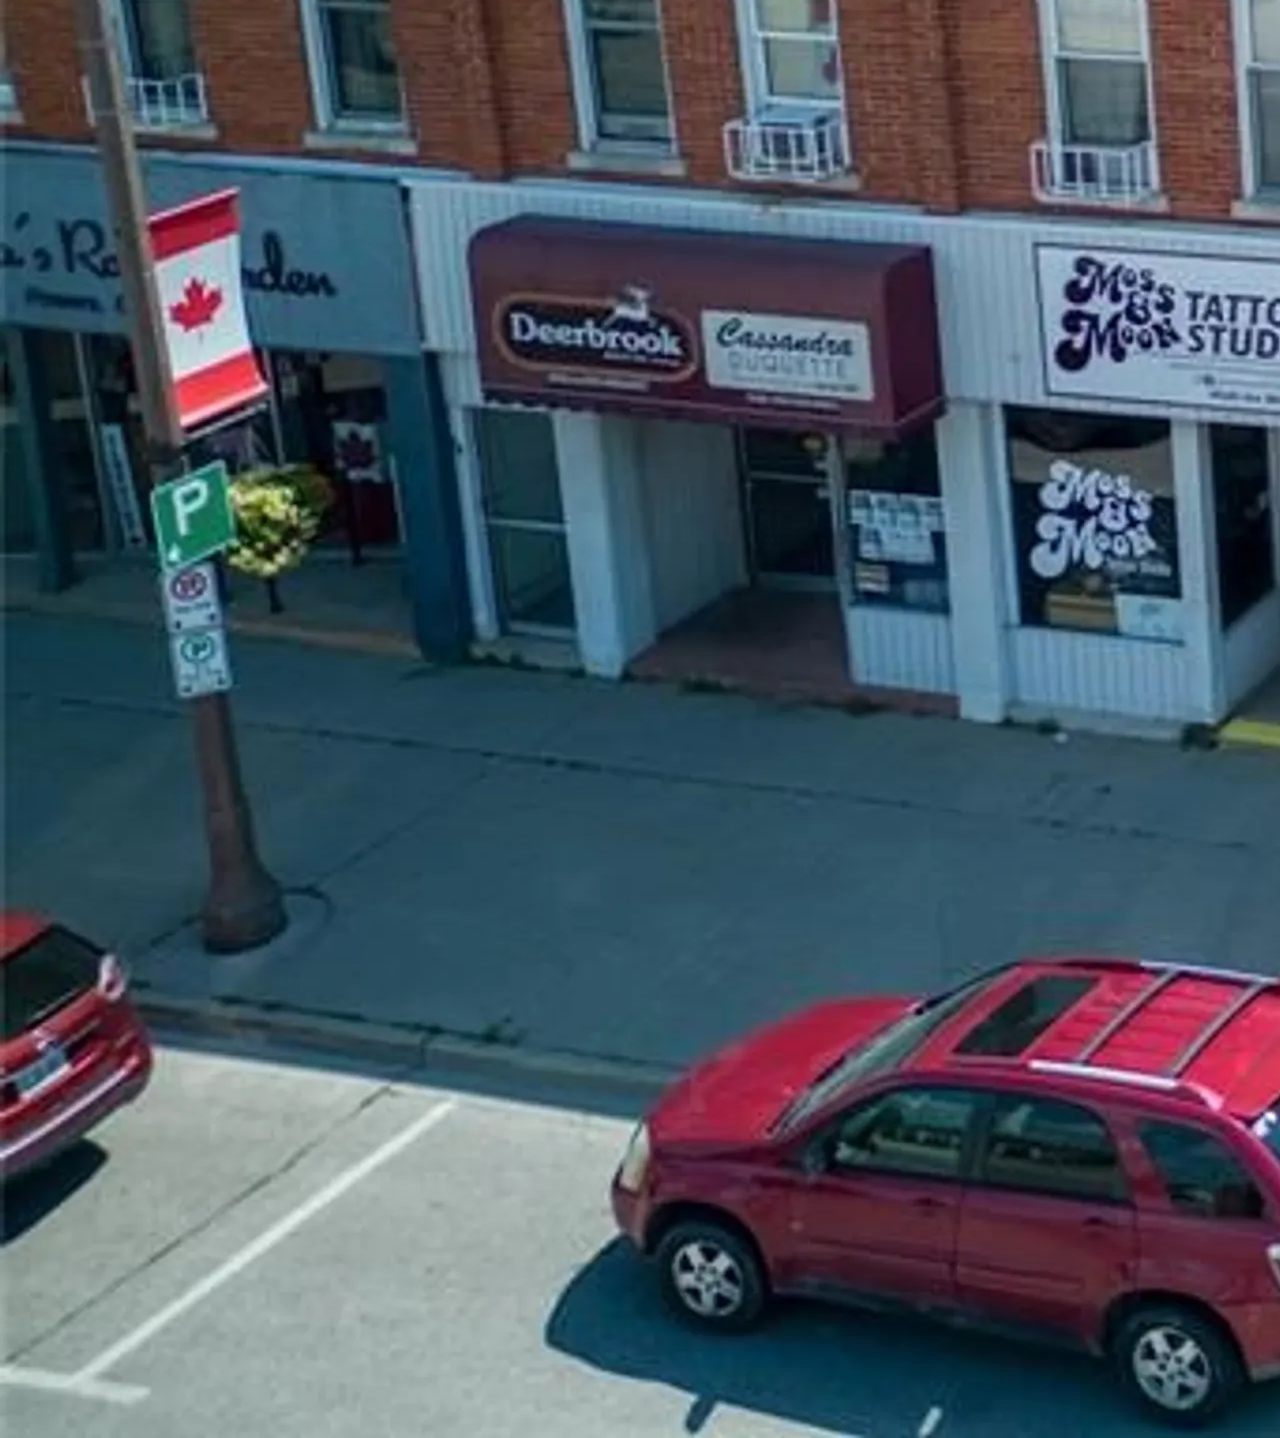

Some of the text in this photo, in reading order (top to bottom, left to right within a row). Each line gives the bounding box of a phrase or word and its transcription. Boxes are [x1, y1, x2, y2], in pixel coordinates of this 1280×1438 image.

[1063, 255, 1177, 314] Moss
[1123, 289, 1152, 325] &
[510, 312, 684, 356] Deerbrook
[716, 317, 854, 357] Cassandra
[1054, 308, 1181, 372] Moon
[173, 477, 209, 537] P
[1037, 459, 1153, 522] Moss
[1030, 512, 1157, 579] Moon
